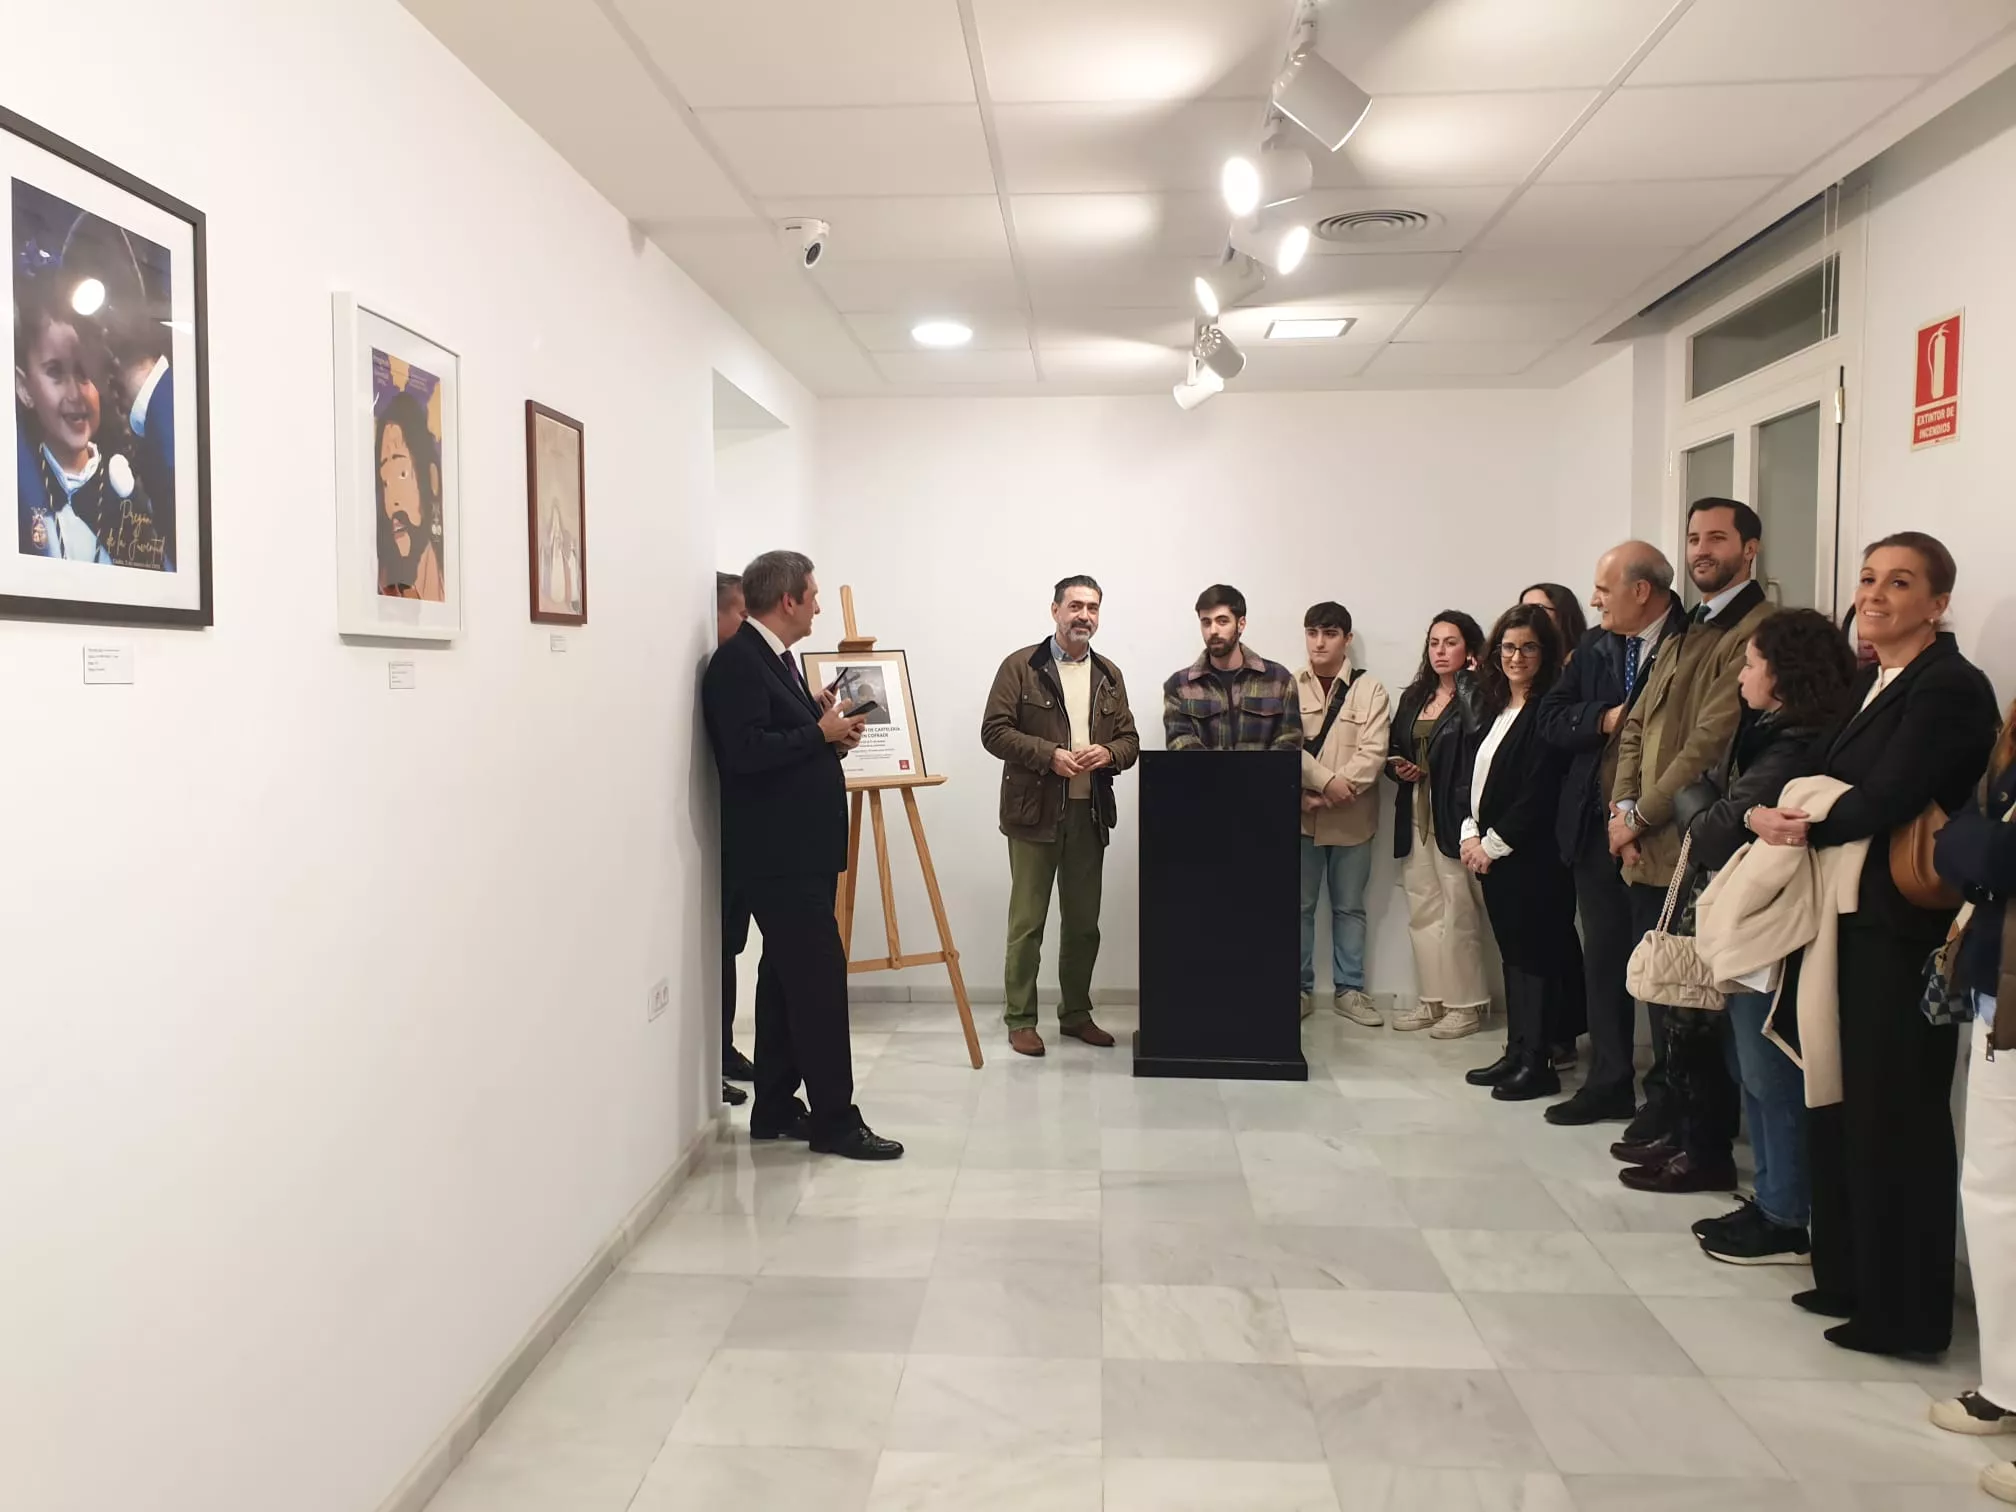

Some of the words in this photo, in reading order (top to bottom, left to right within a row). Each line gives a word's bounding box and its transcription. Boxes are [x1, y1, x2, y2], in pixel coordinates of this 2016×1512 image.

[1916, 408, 1946, 426] EXTINTOR
[1946, 406, 1954, 418] DE
[1919, 422, 1950, 440] INCENDIOS
